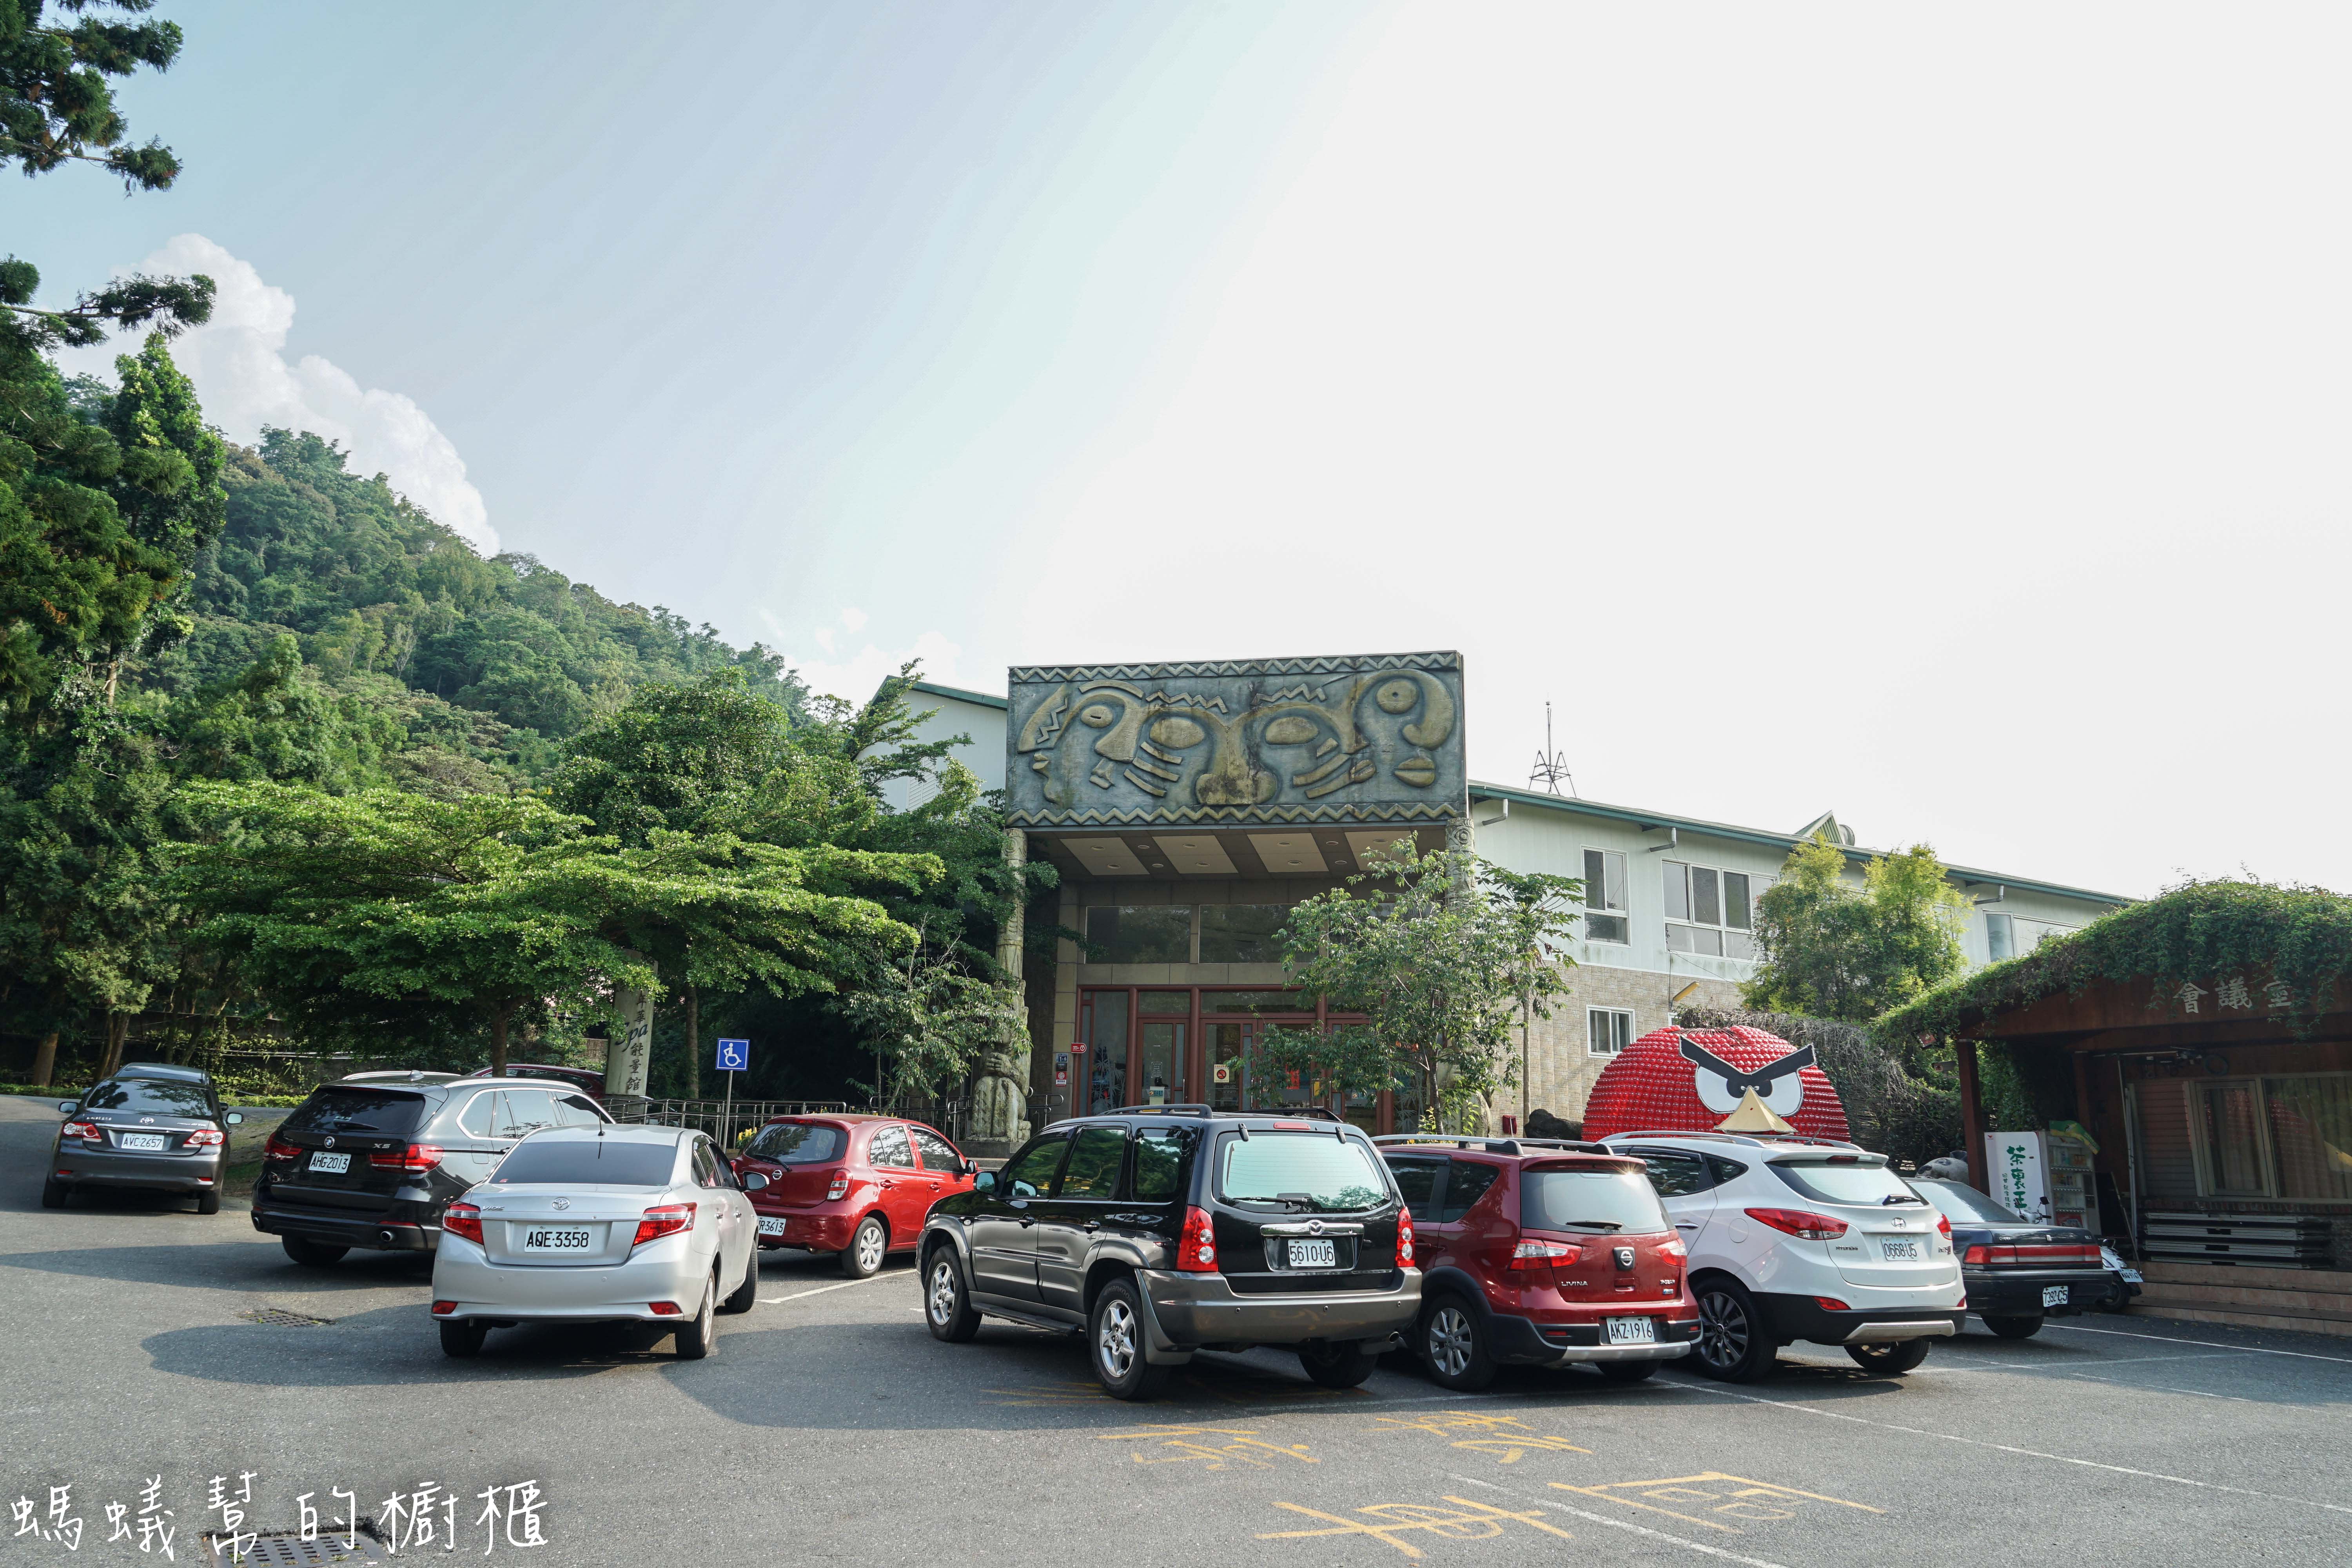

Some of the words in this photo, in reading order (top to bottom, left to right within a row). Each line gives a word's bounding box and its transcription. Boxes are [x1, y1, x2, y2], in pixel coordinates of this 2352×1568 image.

[2173, 976, 2292, 1013] 會議室
[626, 1042, 643, 1091] 能量館
